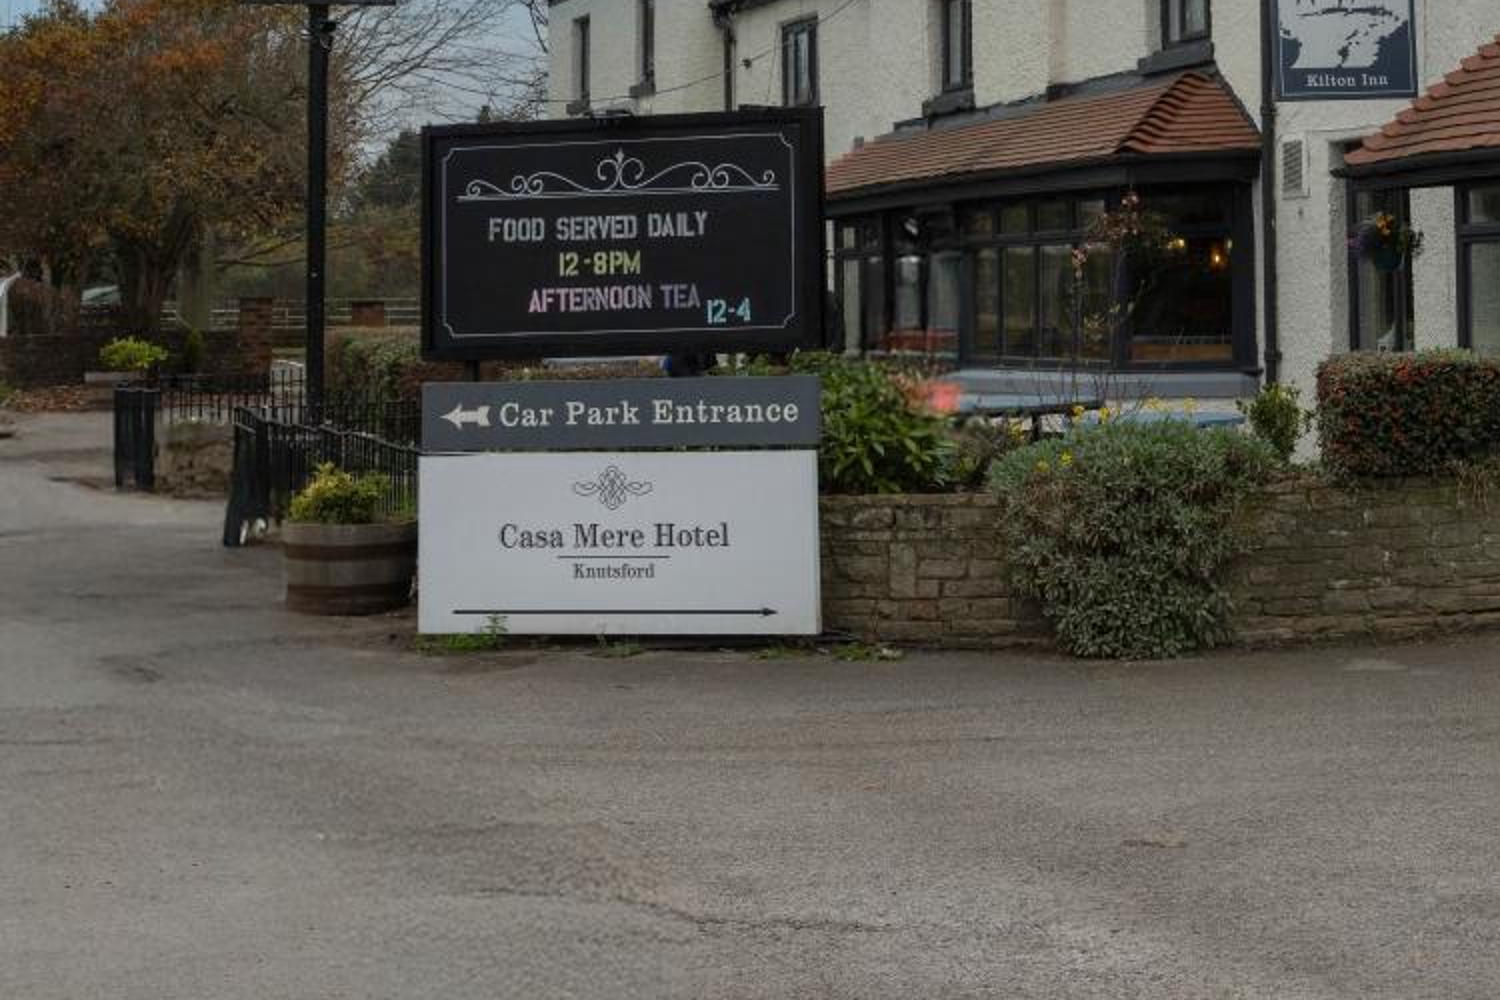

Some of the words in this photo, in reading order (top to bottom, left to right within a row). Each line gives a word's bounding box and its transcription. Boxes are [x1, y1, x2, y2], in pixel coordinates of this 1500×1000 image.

[1306, 73, 1356, 88] Kilton
[1361, 73, 1389, 86] Inn
[488, 216, 546, 242] FOOD
[556, 213, 638, 241] SERVED
[648, 211, 709, 238] DAILY
[528, 285, 653, 313] AFTERNOON
[659, 284, 701, 309] TEA
[707, 298, 752, 324] 12-4
[500, 401, 554, 427] Car
[565, 398, 641, 426] Park
[651, 398, 799, 425] Entrance
[500, 523, 564, 549] Casa
[573, 523, 645, 548] Mere
[653, 521, 730, 548] Hotel
[573, 562, 655, 580] Knutsford
